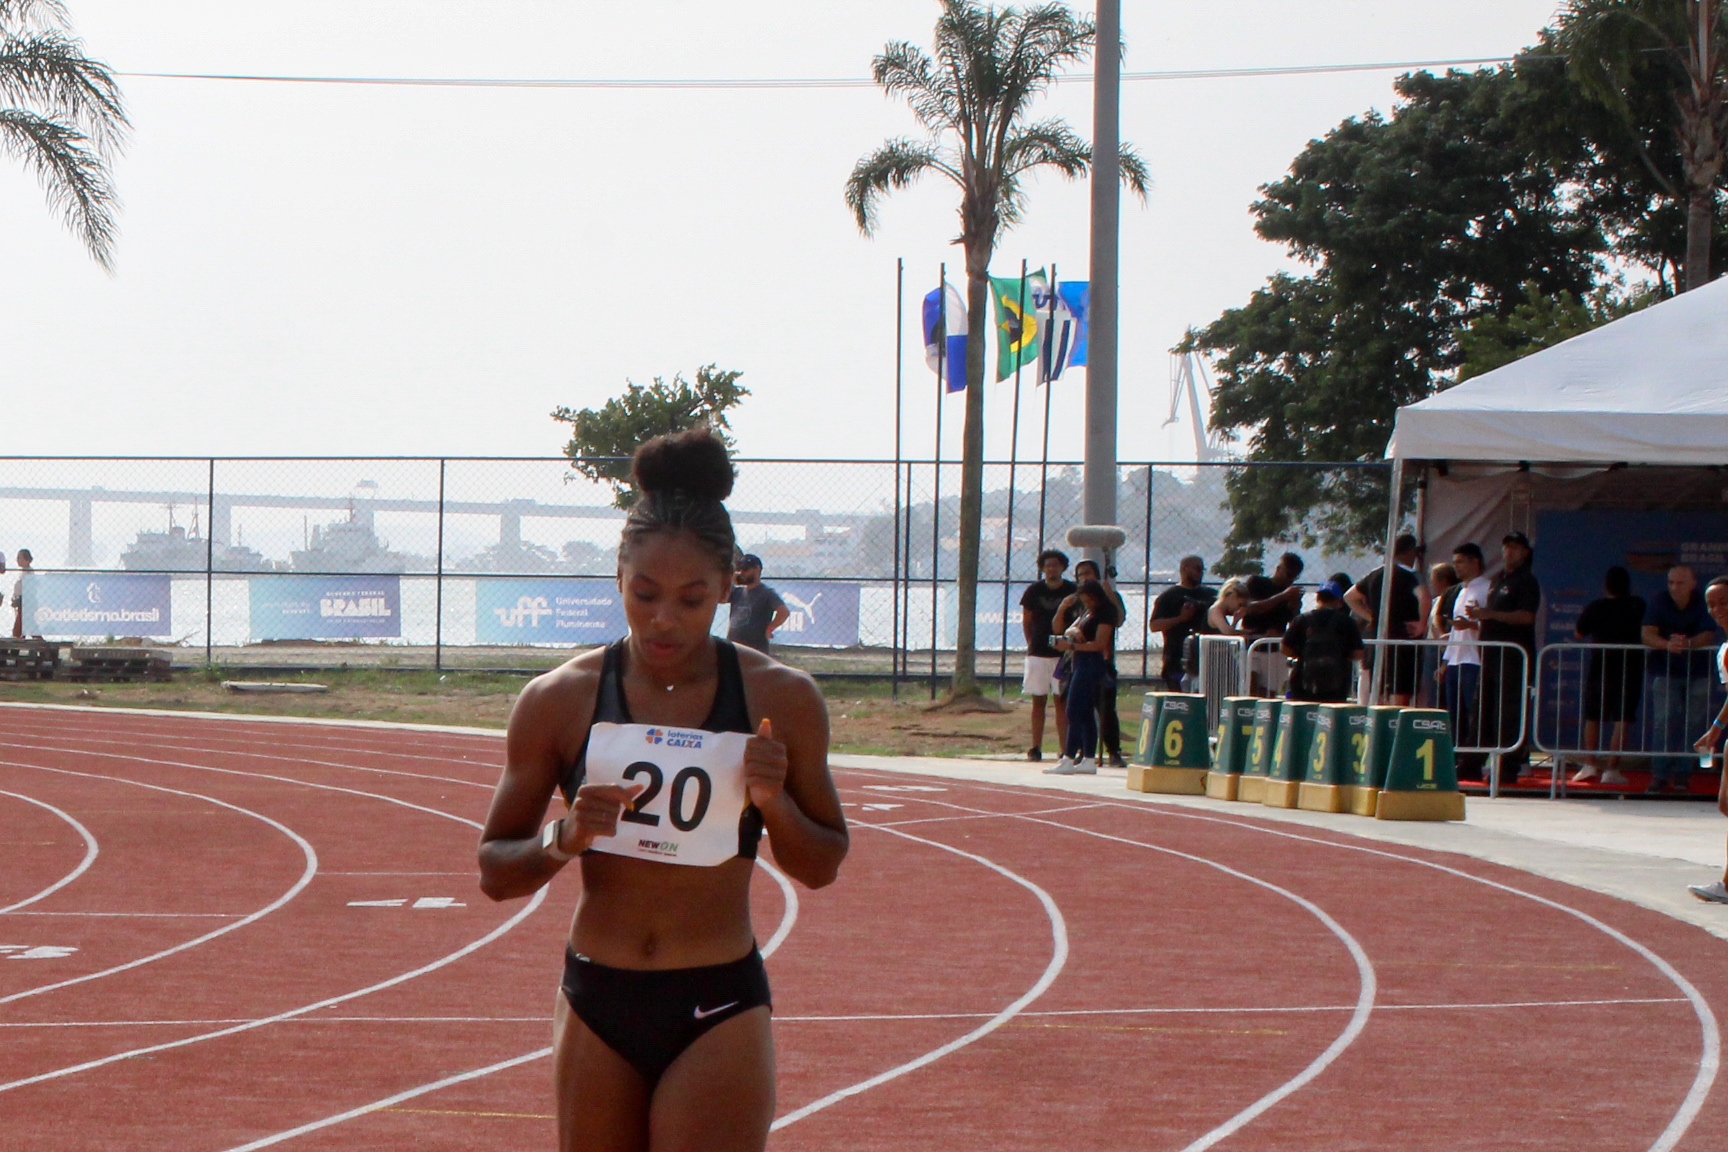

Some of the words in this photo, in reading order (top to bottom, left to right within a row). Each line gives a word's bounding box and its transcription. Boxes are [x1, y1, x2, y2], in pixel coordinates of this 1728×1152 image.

[320, 597, 392, 617] BRASIL
[494, 595, 553, 627] uff
[556, 608, 589, 617] Federal
[667, 730, 703, 741] loterias
[667, 738, 702, 749] CAIXA
[1138, 718, 1150, 755] 8
[1163, 719, 1185, 758] 6
[1215, 724, 1227, 762] 7
[1251, 725, 1265, 765] 5
[1274, 730, 1285, 769] 4
[1313, 731, 1327, 772] 3
[1415, 738, 1435, 781] 1
[621, 761, 712, 832] 20
